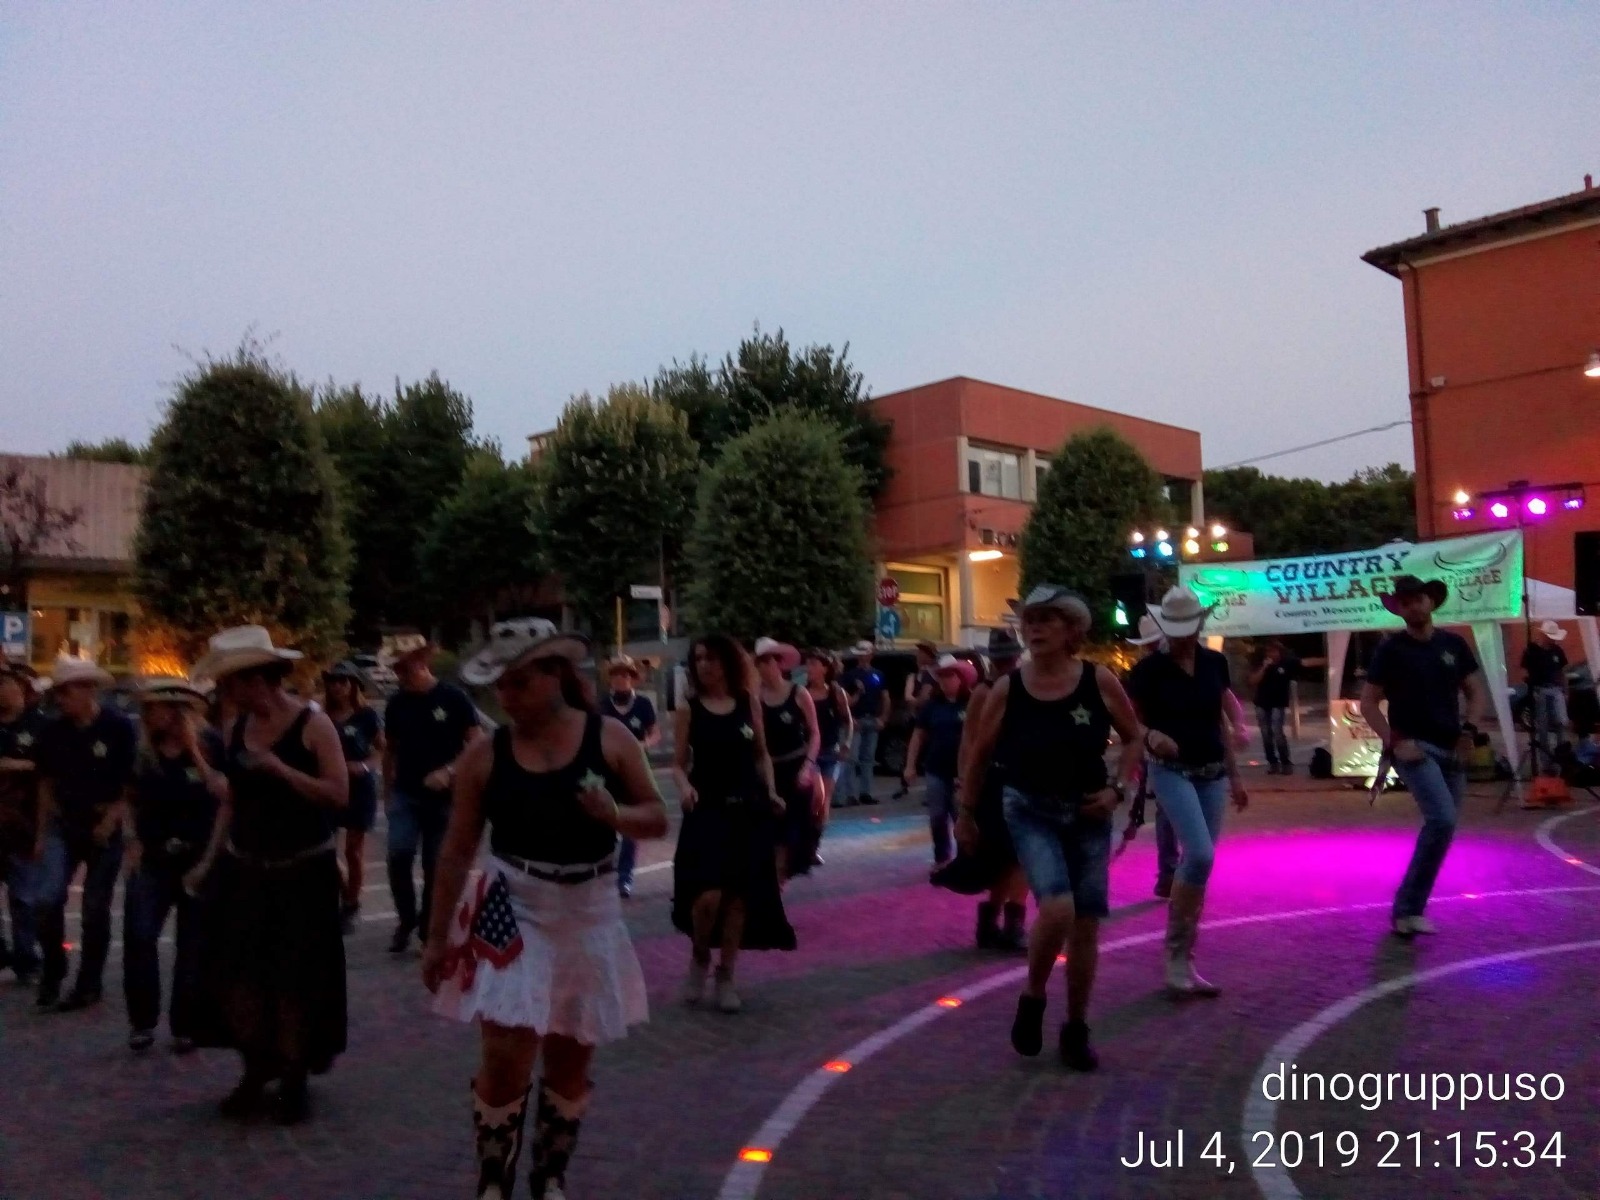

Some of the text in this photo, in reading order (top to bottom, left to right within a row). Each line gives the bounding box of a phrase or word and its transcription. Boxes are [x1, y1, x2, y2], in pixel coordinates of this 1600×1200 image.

[1265, 551, 1411, 583] COUNTRY
[877, 584, 898, 599] STOP
[4, 614, 24, 642] P
